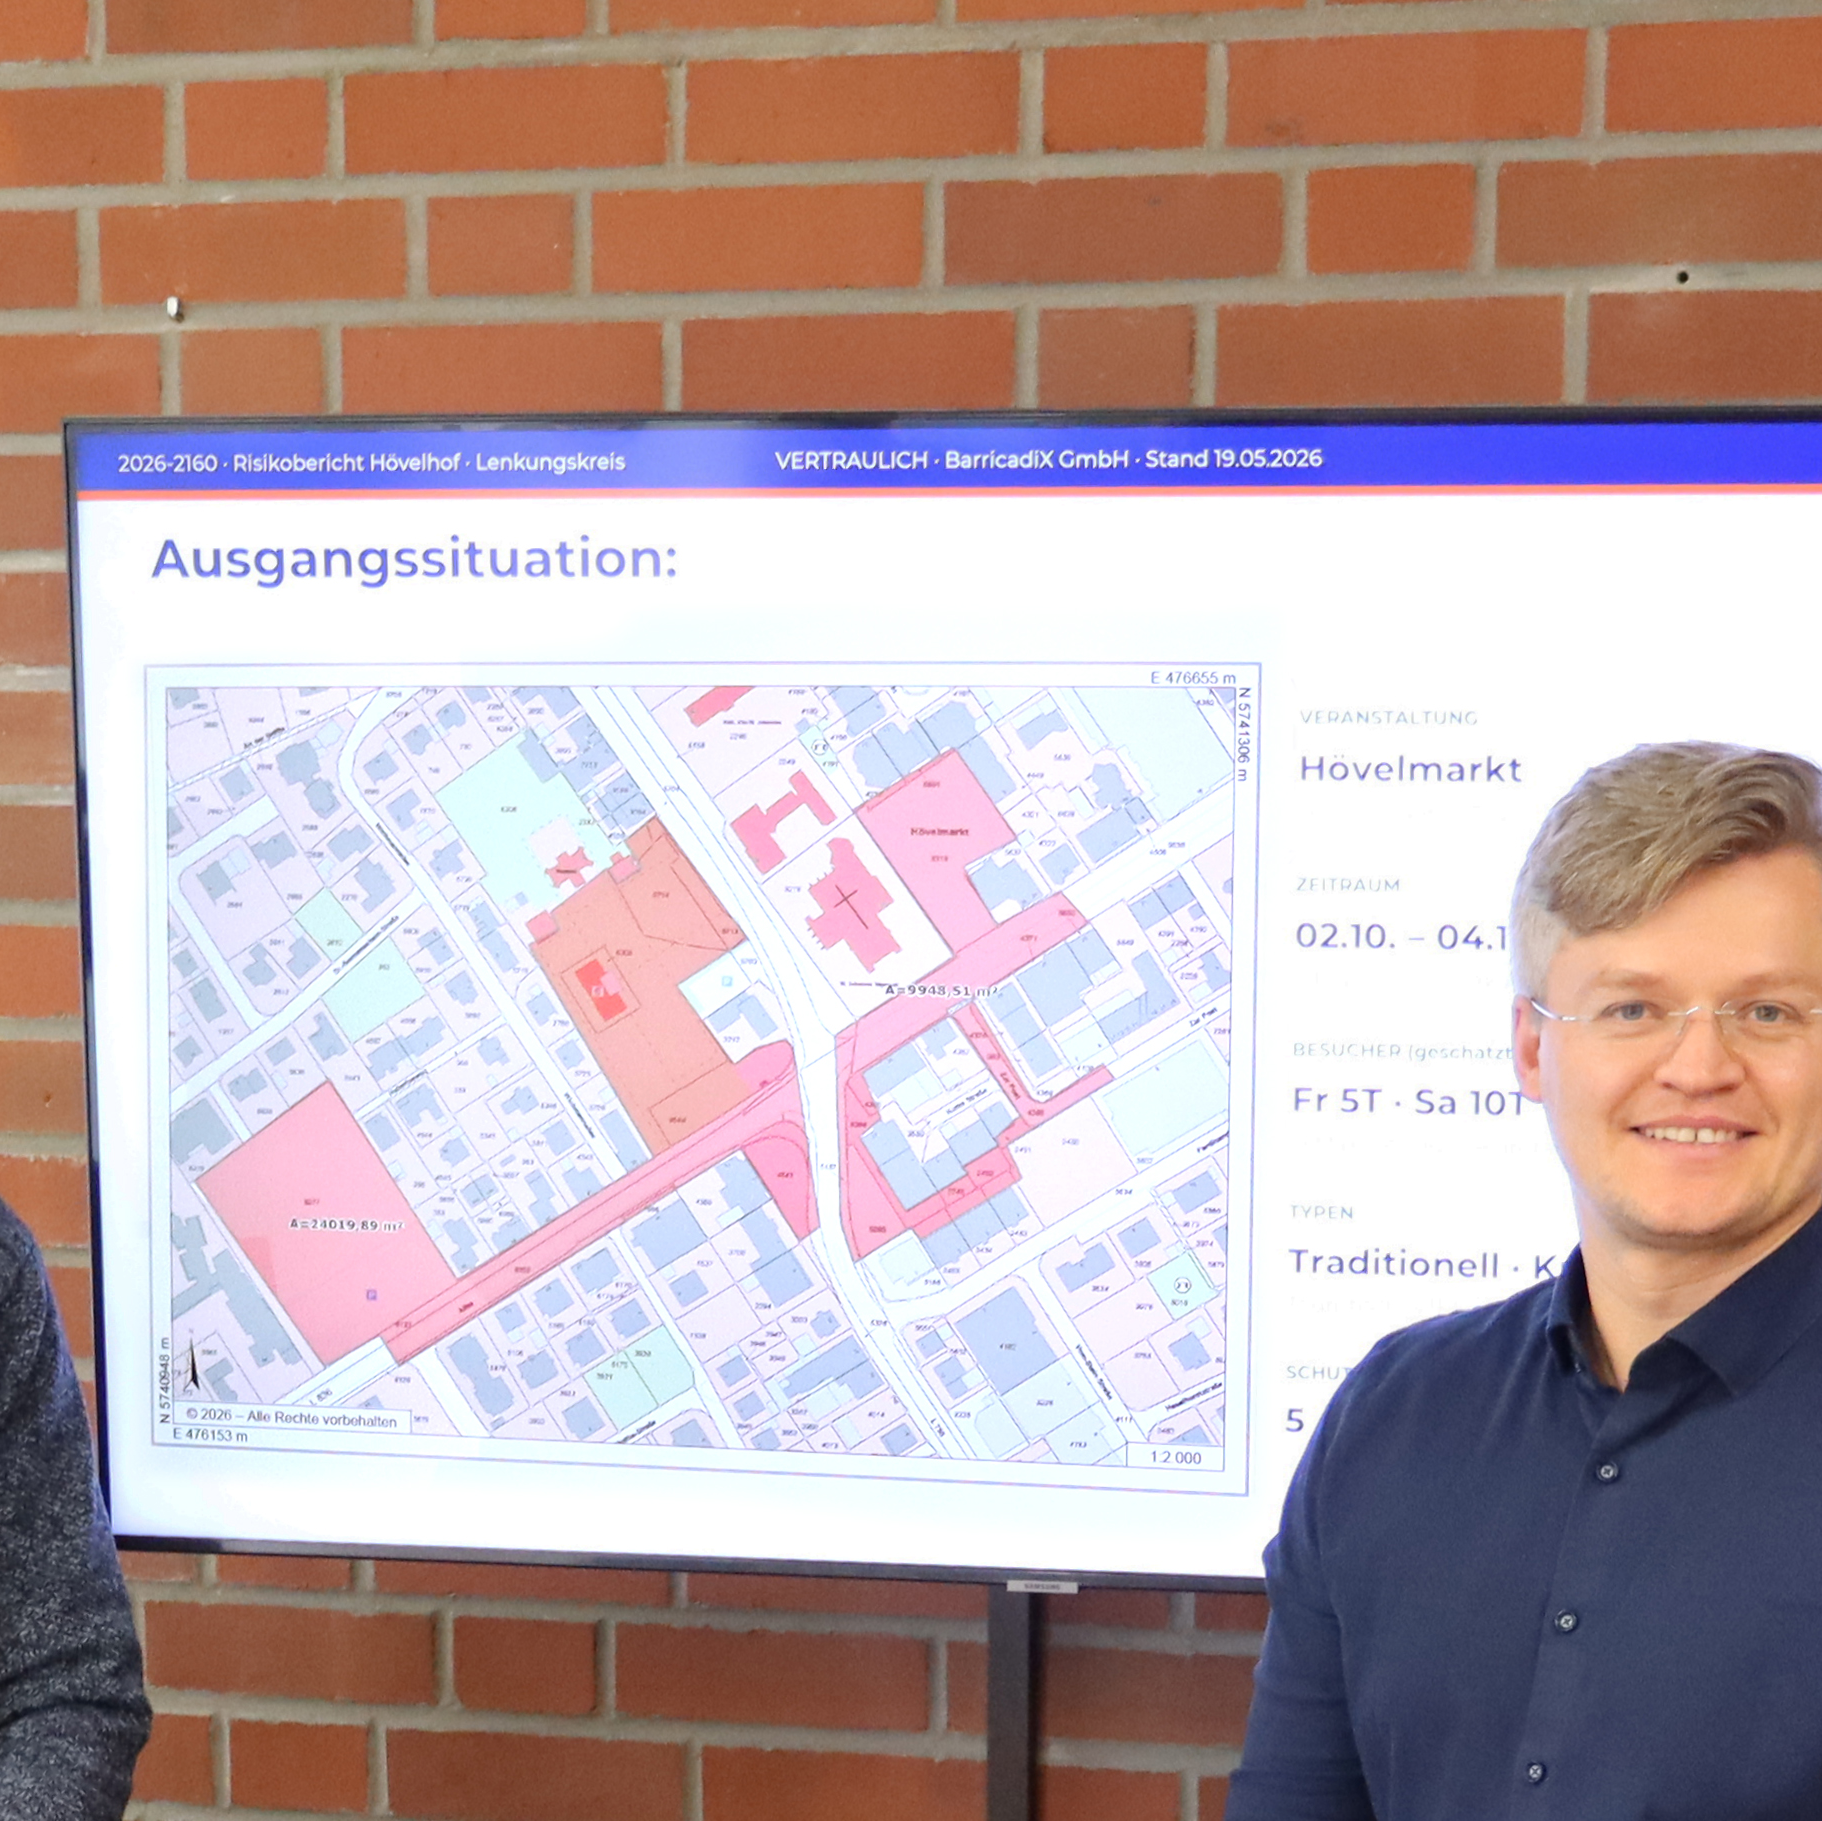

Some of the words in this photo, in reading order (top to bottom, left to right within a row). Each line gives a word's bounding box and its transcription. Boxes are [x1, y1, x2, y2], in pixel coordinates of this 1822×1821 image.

[118, 454, 219, 473] 2026-2160
[233, 452, 365, 473] Risikobericht
[370, 452, 461, 473] Hövelhof
[476, 452, 626, 476] Lenkungskreis
[775, 451, 928, 471] VERTRAULICH
[945, 449, 1054, 470] BarricadiX
[1059, 449, 1130, 470] GmbH
[1145, 448, 1209, 469] Stand
[1214, 448, 1324, 469] 19.05.2026
[151, 534, 678, 588] Ausgangssituation:
[1151, 671, 1160, 684] E
[1165, 671, 1219, 684] 476655
[1223, 674, 1237, 684] m
[1238, 687, 1252, 698] N
[1300, 710, 1478, 726] VERANSTALTUNG
[1237, 702, 1251, 764] 5741306
[1237, 768, 1247, 782] m
[1300, 753, 1523, 783] Hövelmarkt
[1296, 877, 1401, 892] ZEITRAUM
[1296, 922, 1396, 949] 02.10.
[1293, 1042, 1401, 1058] BESUCHER
[1293, 1086, 1329, 1113] Fr
[1341, 1087, 1383, 1114] 5T
[1415, 1088, 1457, 1115] Sa
[1290, 1204, 1355, 1220] TYPEN
[1288, 1247, 1499, 1279] Traditionell
[161, 1337, 170, 1348] m
[159, 1354, 170, 1409] 5740948
[160, 1413, 170, 1424] N
[200, 1408, 233, 1421] 2026
[247, 1410, 272, 1423] Alle
[274, 1411, 319, 1425] Rechte
[322, 1413, 398, 1428] vorbehalten
[1285, 1408, 1305, 1432] 5
[173, 1428, 182, 1439] E
[185, 1428, 233, 1441] 476153
[236, 1432, 248, 1442] m
